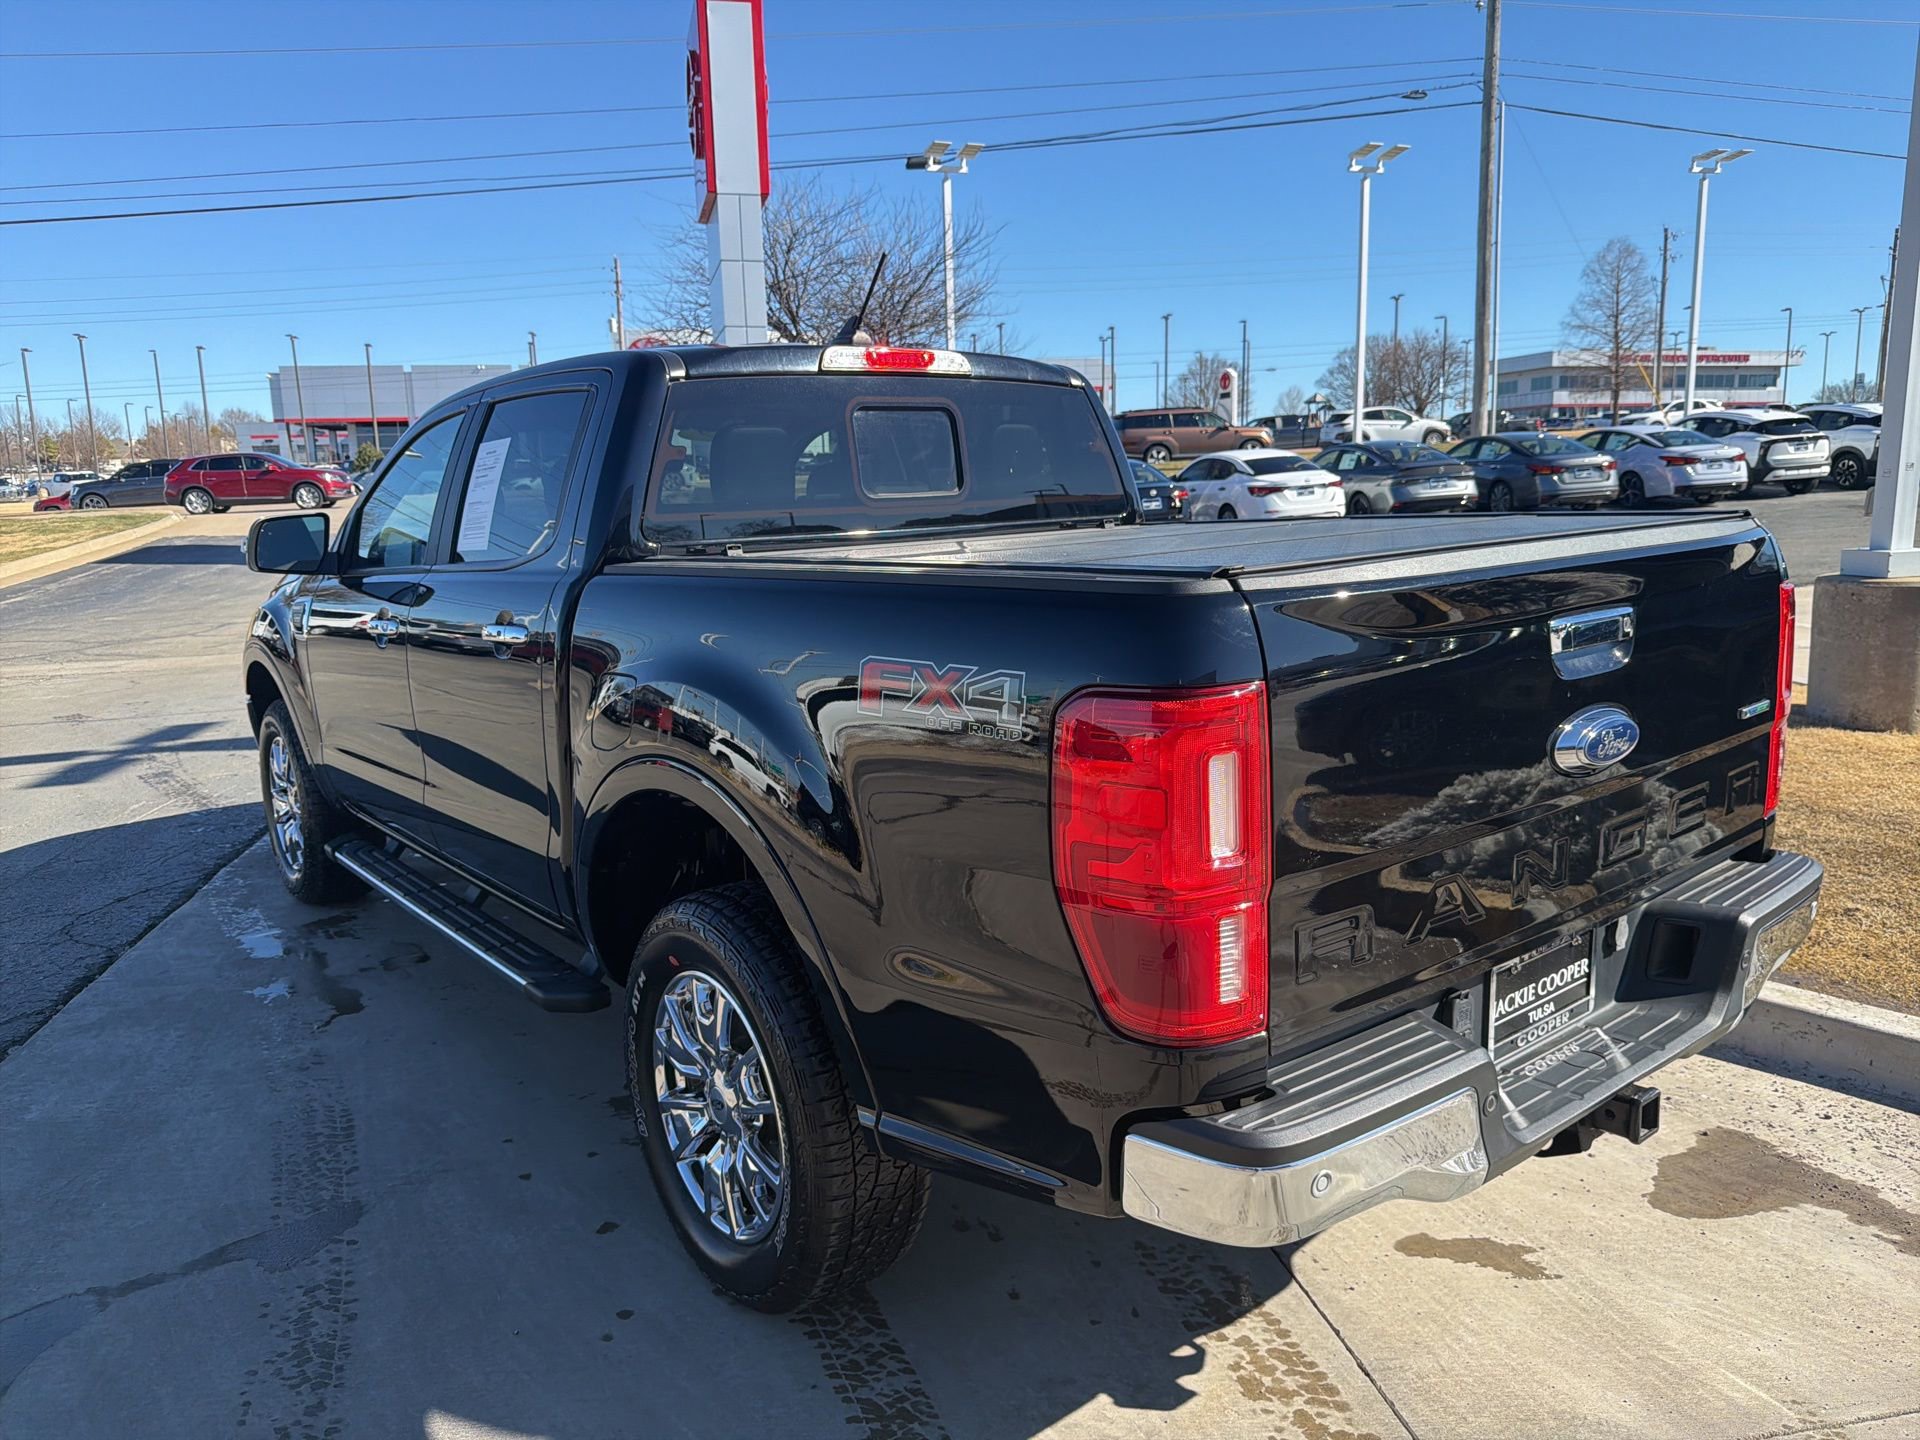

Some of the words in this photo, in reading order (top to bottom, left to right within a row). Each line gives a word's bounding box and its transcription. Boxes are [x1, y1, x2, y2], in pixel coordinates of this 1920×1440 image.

[857, 655, 1026, 729] FX4
[925, 715, 962, 731] OFF
[968, 722, 1023, 742] ROAD
[1597, 726, 1631, 758] Ford
[1294, 761, 1760, 985] RANGER
[1537, 958, 1589, 996] COOPER
[1516, 1011, 1570, 1047] COOPER
[1528, 1001, 1555, 1023] TULSA
